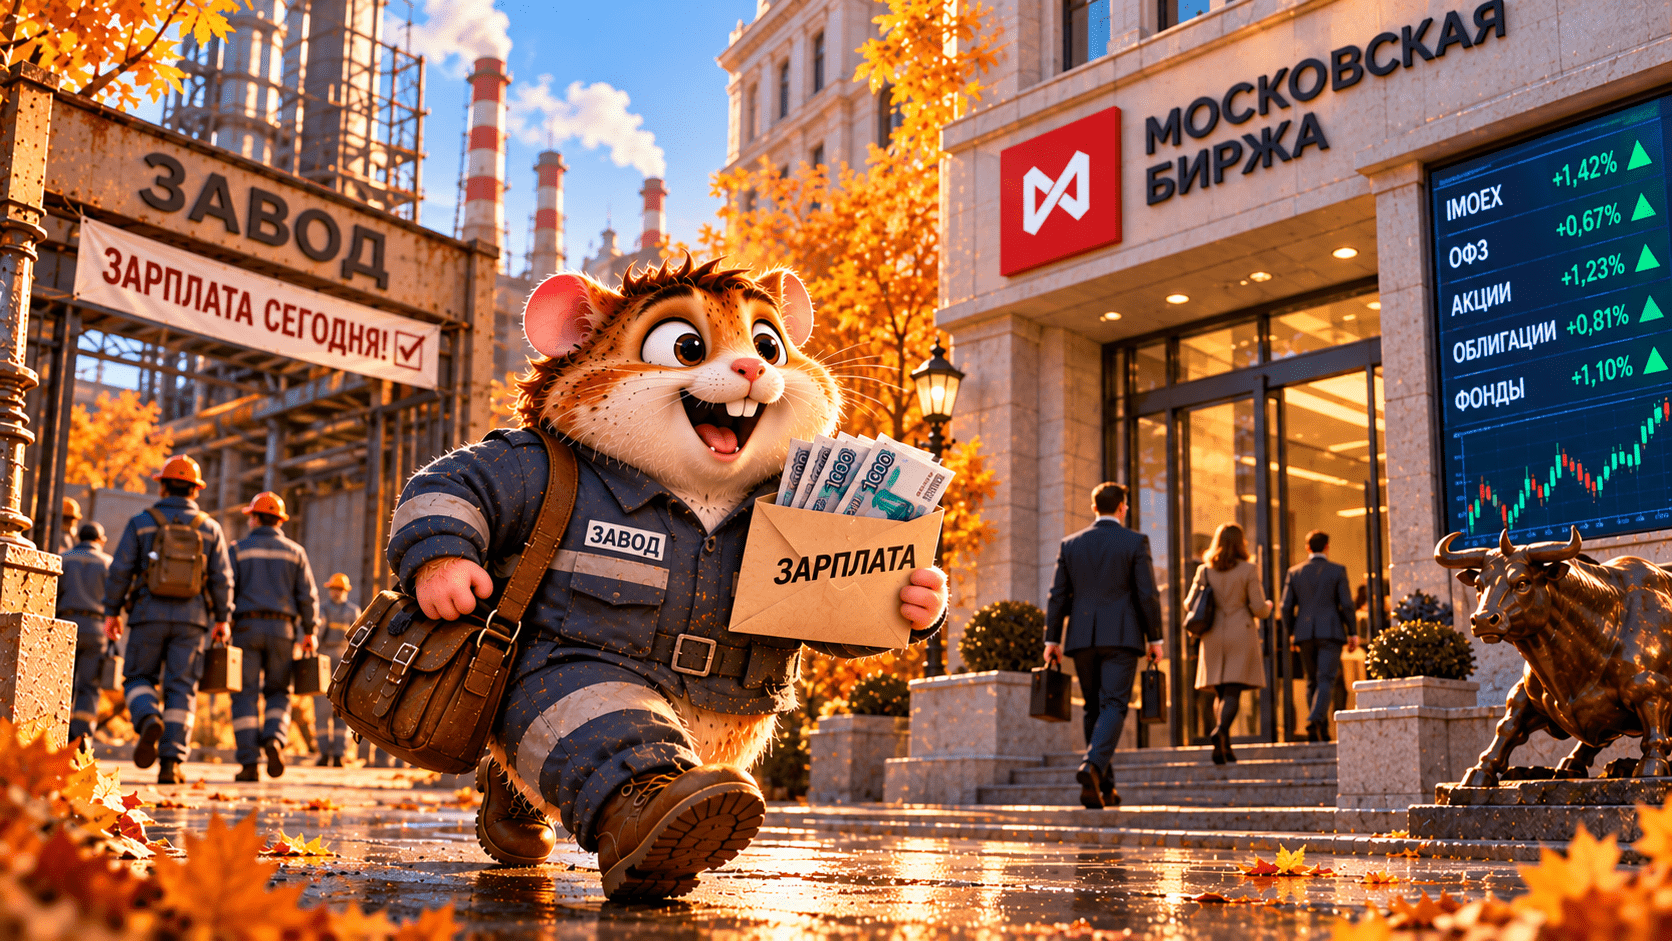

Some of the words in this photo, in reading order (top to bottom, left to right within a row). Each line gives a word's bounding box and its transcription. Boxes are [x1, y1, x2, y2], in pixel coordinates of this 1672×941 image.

[1145, 0, 1506, 155] МОСКОВСКАЯ
[1146, 112, 1330, 206] БИРЖА
[1446, 184, 1503, 222] IMOEX
[1553, 150, 1618, 188] +1,42%
[140, 152, 390, 290] ЗАВОД
[1449, 238, 1489, 269] ОФЗ
[1556, 202, 1622, 238] +0,67%
[102, 247, 254, 327] ЗАРПЛАТА
[264, 298, 389, 361] СЕГОДНЯ!
[1451, 281, 1512, 317] АКЦИИ
[1561, 253, 1626, 288] +1,23%
[1453, 320, 1557, 364] ОБЛИГАЦИИ
[1566, 304, 1629, 337] +0,81%
[1454, 377, 1525, 412] ФОНДЫ
[1571, 355, 1634, 388] +1,10%
[861, 450, 895, 494] 1000
[590, 525, 660, 557] ЗАВОД
[773, 544, 916, 585] ЗАРПЛАТА
